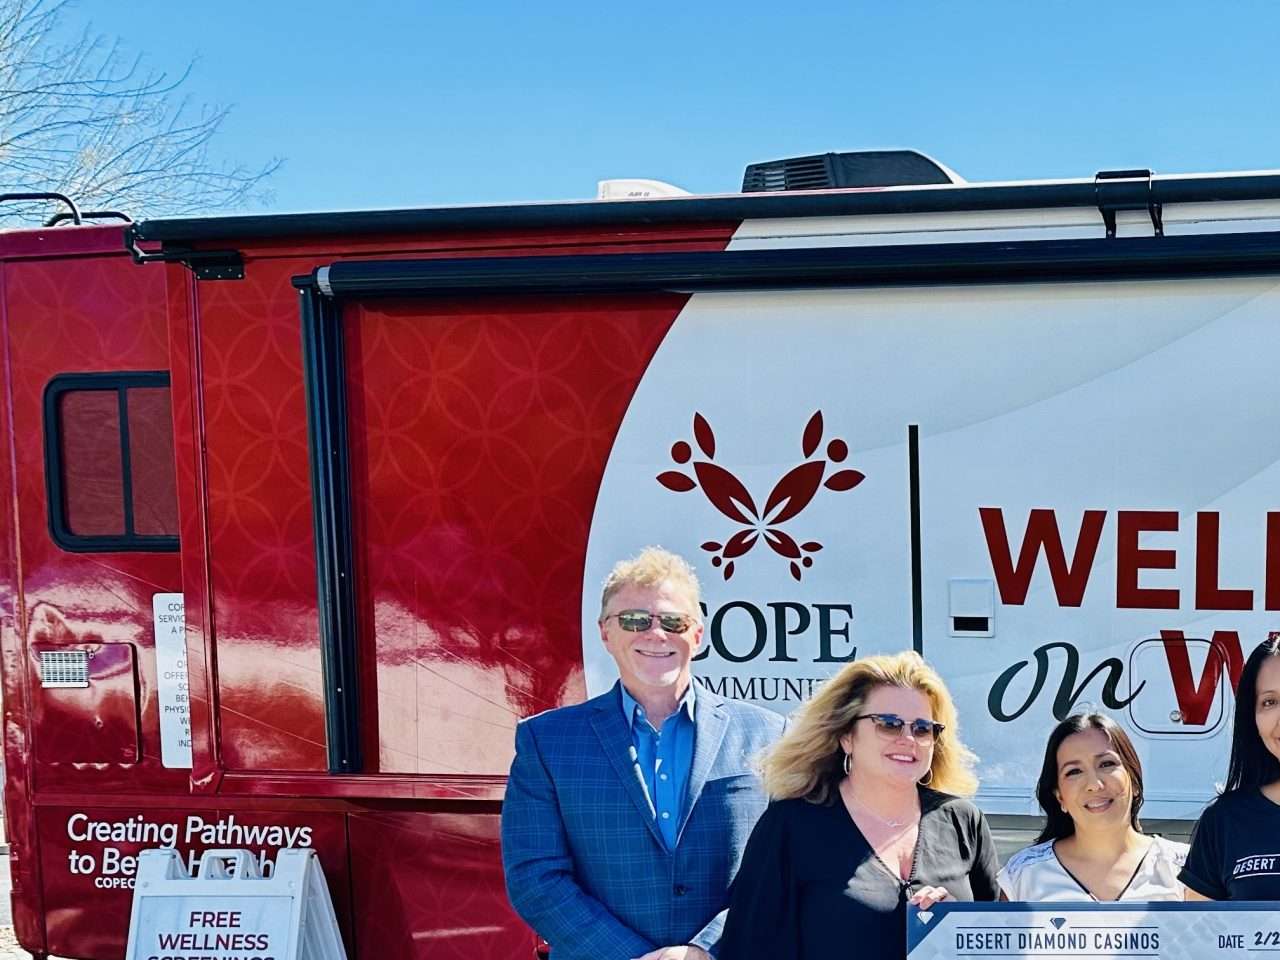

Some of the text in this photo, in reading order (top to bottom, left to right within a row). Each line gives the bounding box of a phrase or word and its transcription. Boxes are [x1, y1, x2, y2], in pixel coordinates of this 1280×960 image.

[987, 641, 1146, 722] on
[67, 813, 313, 849] Creating Pathways
[68, 849, 96, 874] to
[1233, 857, 1275, 875] DESERT
[189, 911, 242, 928] FREE
[158, 933, 269, 951] WELLNESS
[956, 932, 1160, 950] DESERT DIAMOND CASINOS
[1218, 934, 1244, 949] DATE
